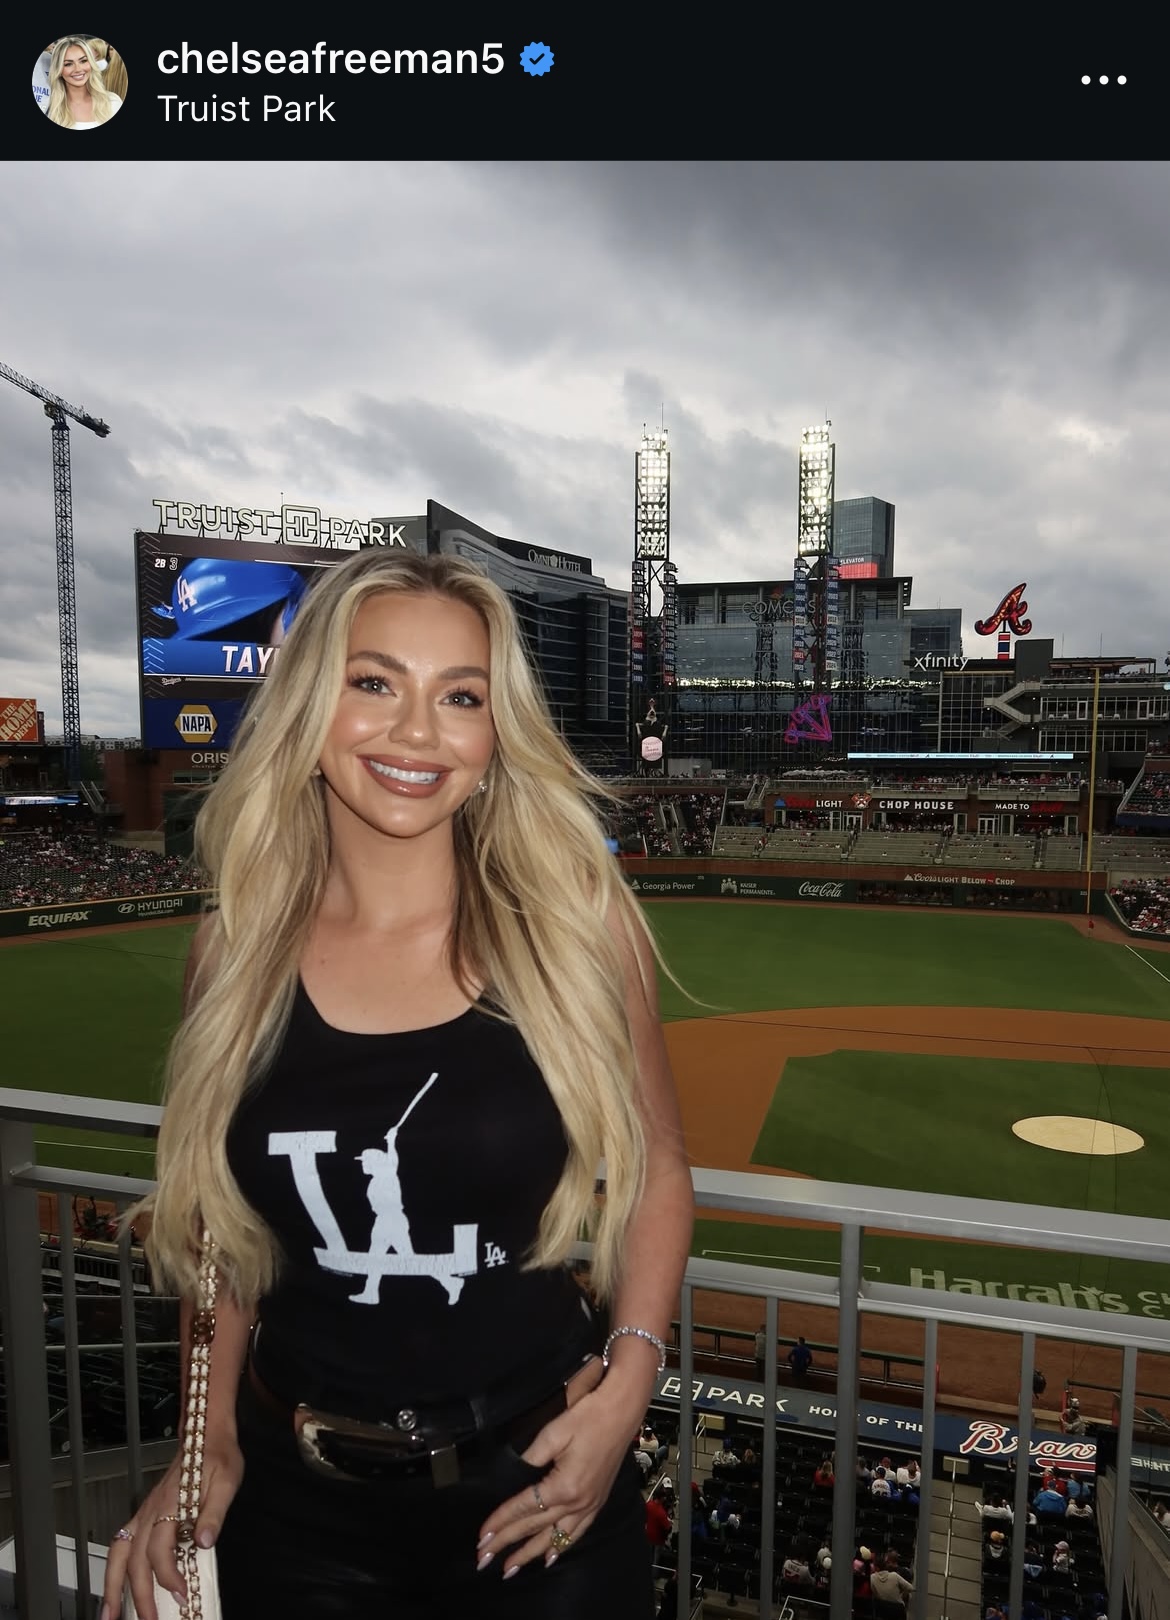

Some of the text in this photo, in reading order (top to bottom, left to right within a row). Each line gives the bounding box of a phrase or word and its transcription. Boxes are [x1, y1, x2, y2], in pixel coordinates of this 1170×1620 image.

[153, 500, 407, 548] TRUIST PARK
[154, 557, 178, 570] 2B 3
[528, 549, 550, 566] OMNI
[913, 652, 969, 671] xfinity
[182, 716, 211, 731] NAPA
[191, 752, 229, 764] ORIS
[816, 800, 843, 808] LIGHT
[879, 800, 954, 810] CHOP HOUSE
[643, 882, 695, 891] Georgia Power
[798, 881, 845, 898] Coca-Cola
[137, 898, 184, 911] HYUNDAI
[28, 911, 89, 927] EQUIFAX
[484, 1241, 507, 1268] LA
[866, 1416, 890, 1426] OF
